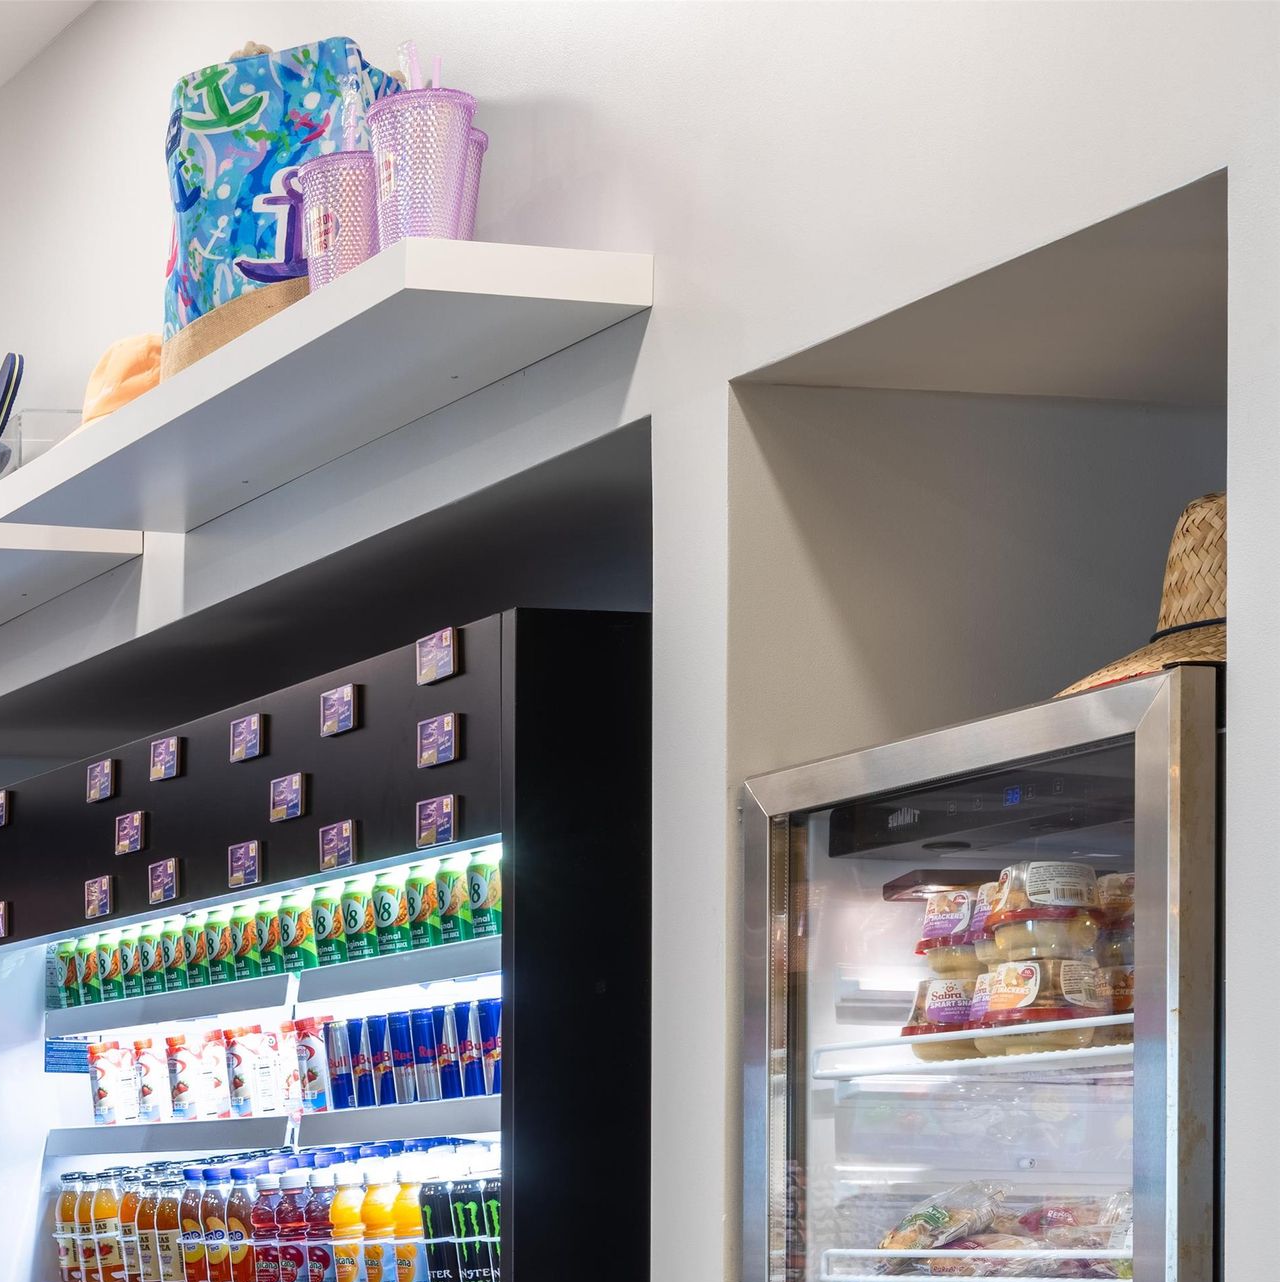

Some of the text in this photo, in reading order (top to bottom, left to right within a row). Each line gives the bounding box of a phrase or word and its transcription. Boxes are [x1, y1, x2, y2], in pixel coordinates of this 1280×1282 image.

[373, 898, 392, 921] V8
[343, 903, 358, 932] V8
[378, 931, 401, 942] riginal
[931, 991, 962, 1001] Sabra
[929, 1000, 956, 1008] SMART
[461, 1268, 491, 1279] NSTE
